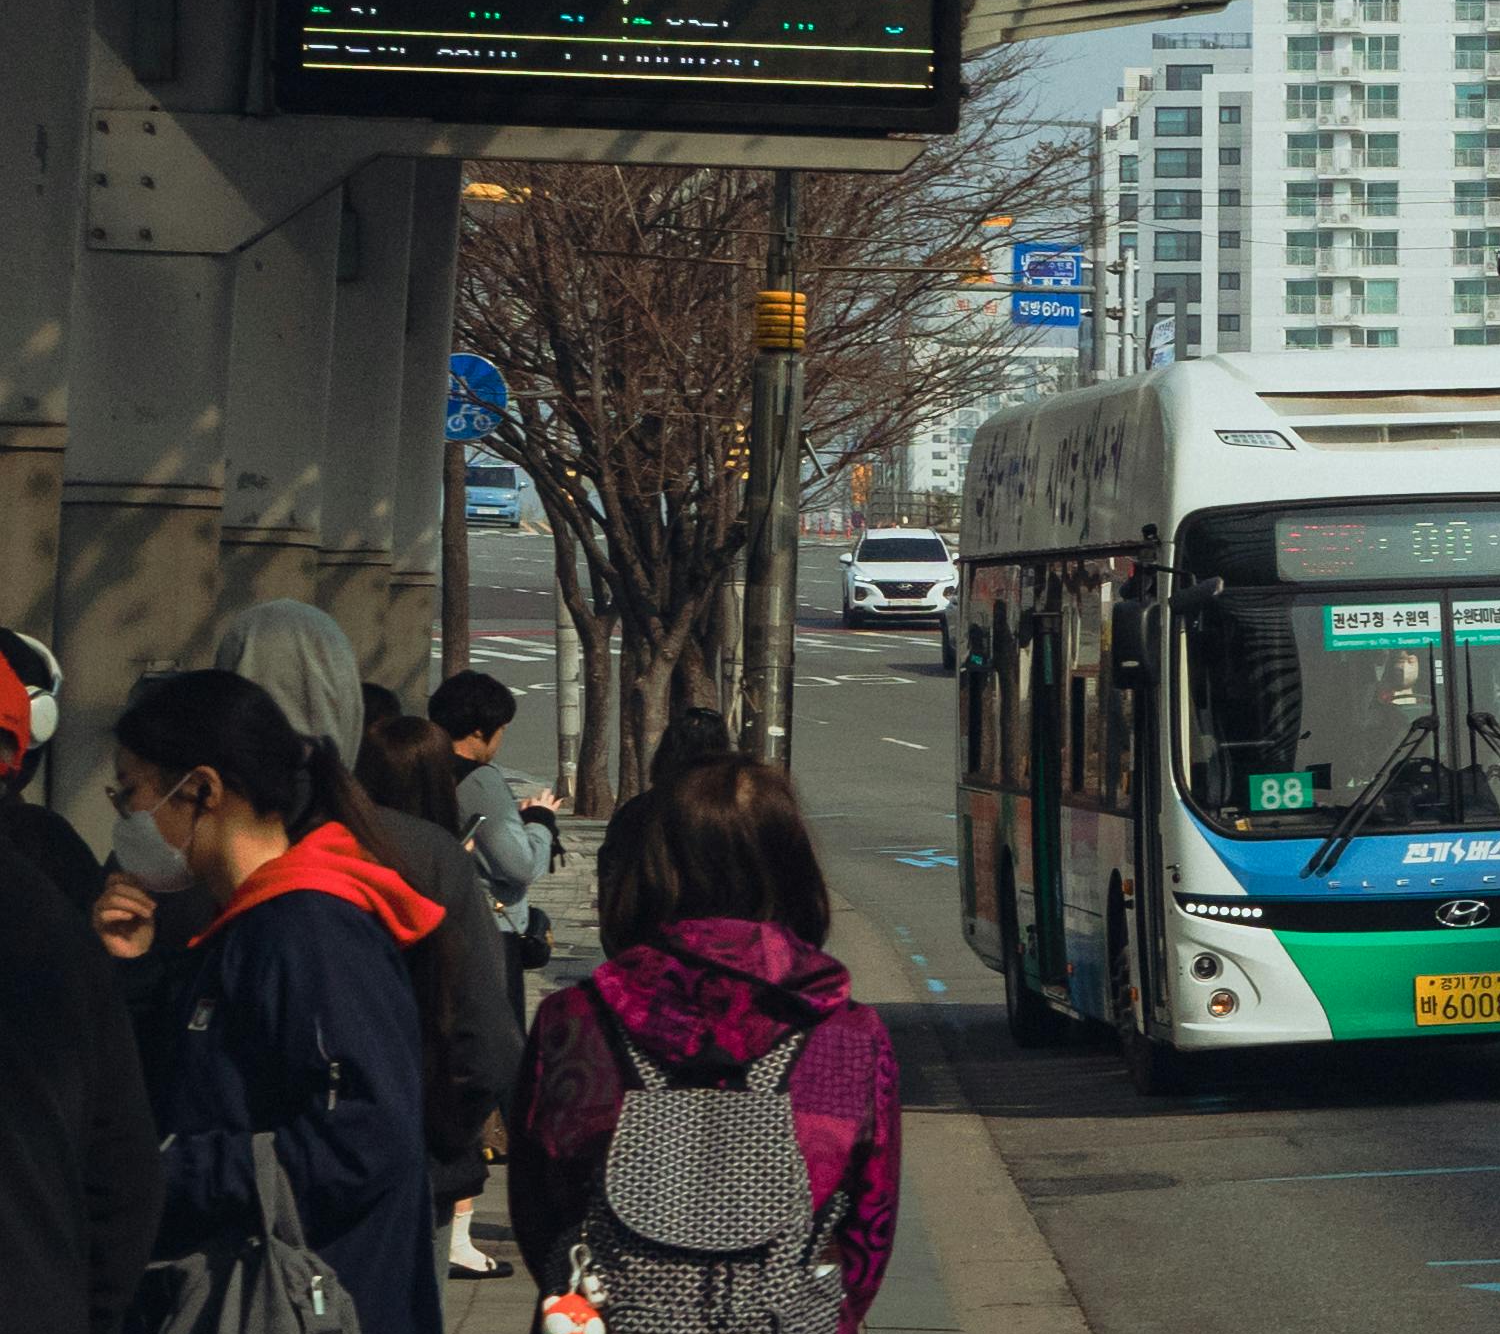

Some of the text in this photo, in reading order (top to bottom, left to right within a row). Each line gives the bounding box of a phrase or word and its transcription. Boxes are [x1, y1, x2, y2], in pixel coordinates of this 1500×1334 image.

[1042, 301, 1075, 317] 60m
[1333, 612, 1385, 629] 권선구청
[1392, 610, 1430, 628] 수원역
[1261, 777, 1304, 810] 88
[1441, 975, 1492, 991] 경기 70
[1420, 995, 1438, 1016] 바
